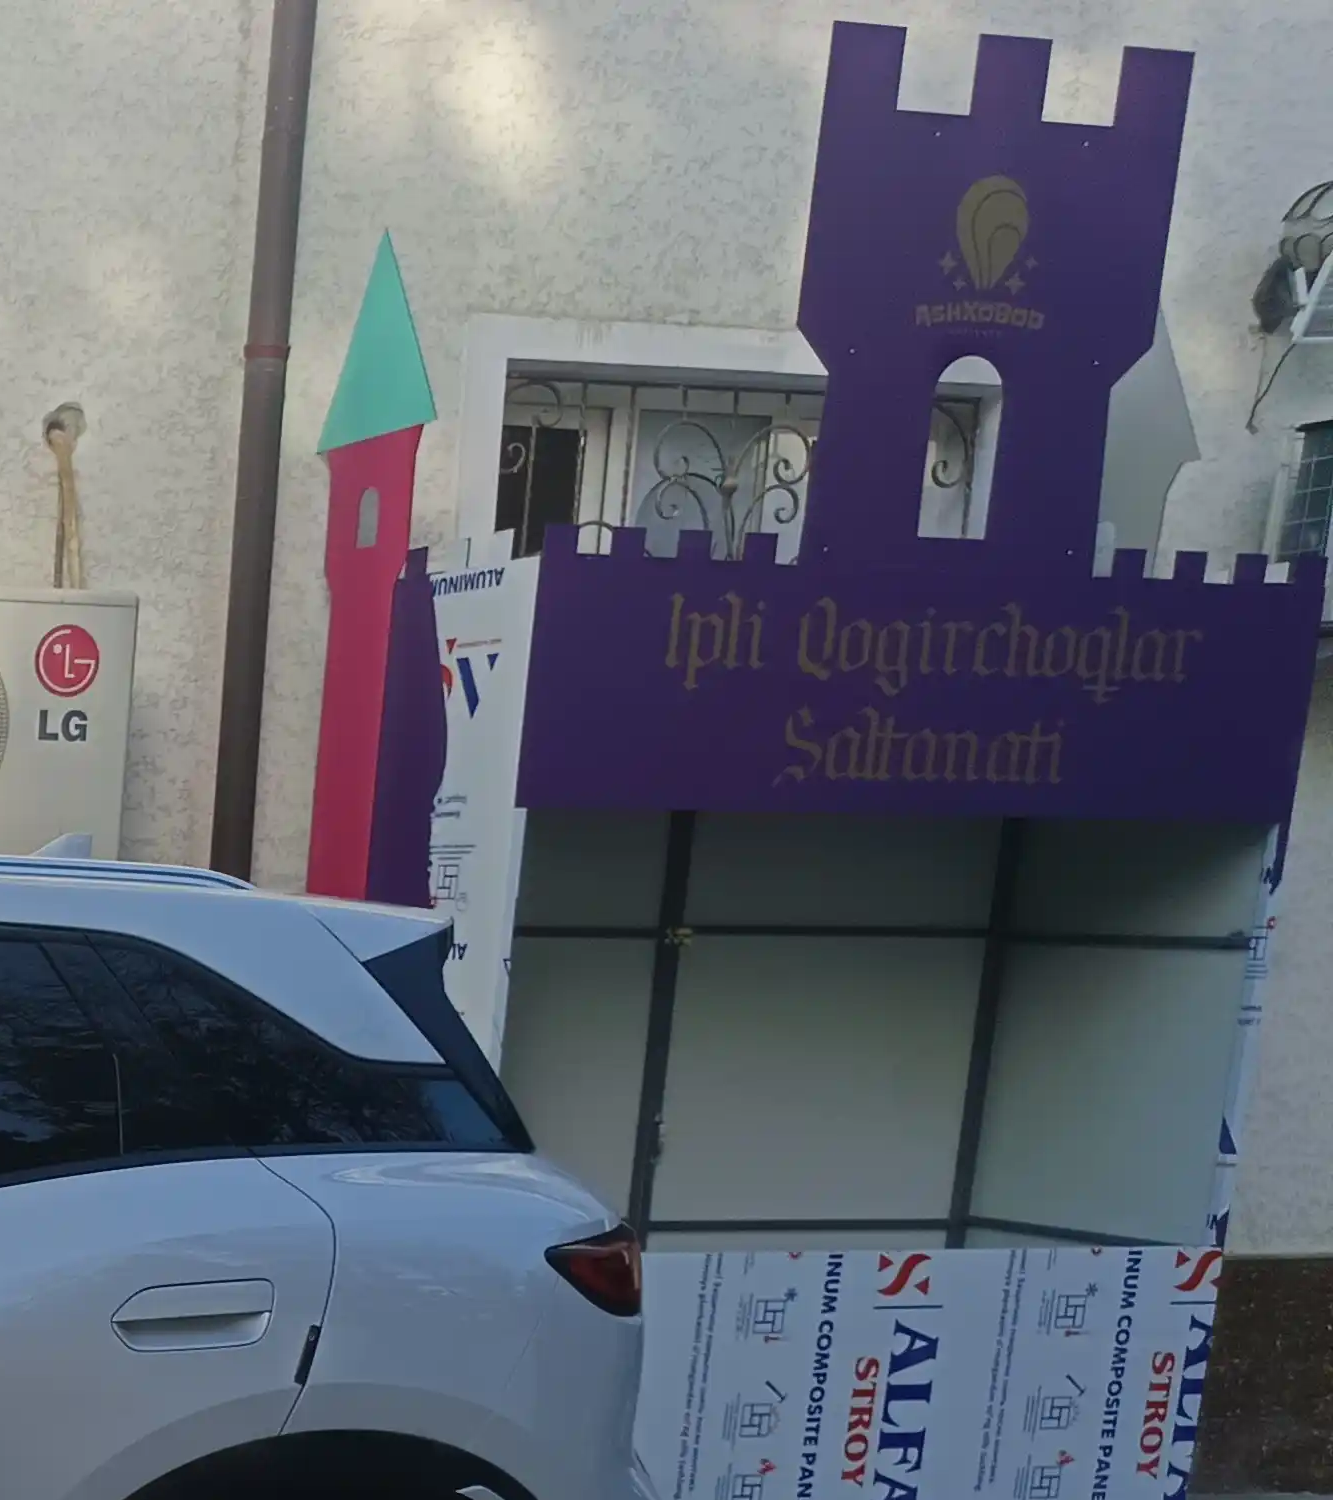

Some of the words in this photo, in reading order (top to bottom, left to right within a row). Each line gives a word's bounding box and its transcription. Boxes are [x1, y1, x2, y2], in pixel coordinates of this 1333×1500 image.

[664, 589, 767, 690] Ipli
[37, 709, 88, 742] LG
[771, 703, 1066, 788] Saltanati
[802, 1319, 834, 1447] COMPOSITE
[840, 1355, 880, 1488] STROY
[1100, 1314, 1133, 1440] COMPOSITE
[1136, 1350, 1176, 1480] STROY
